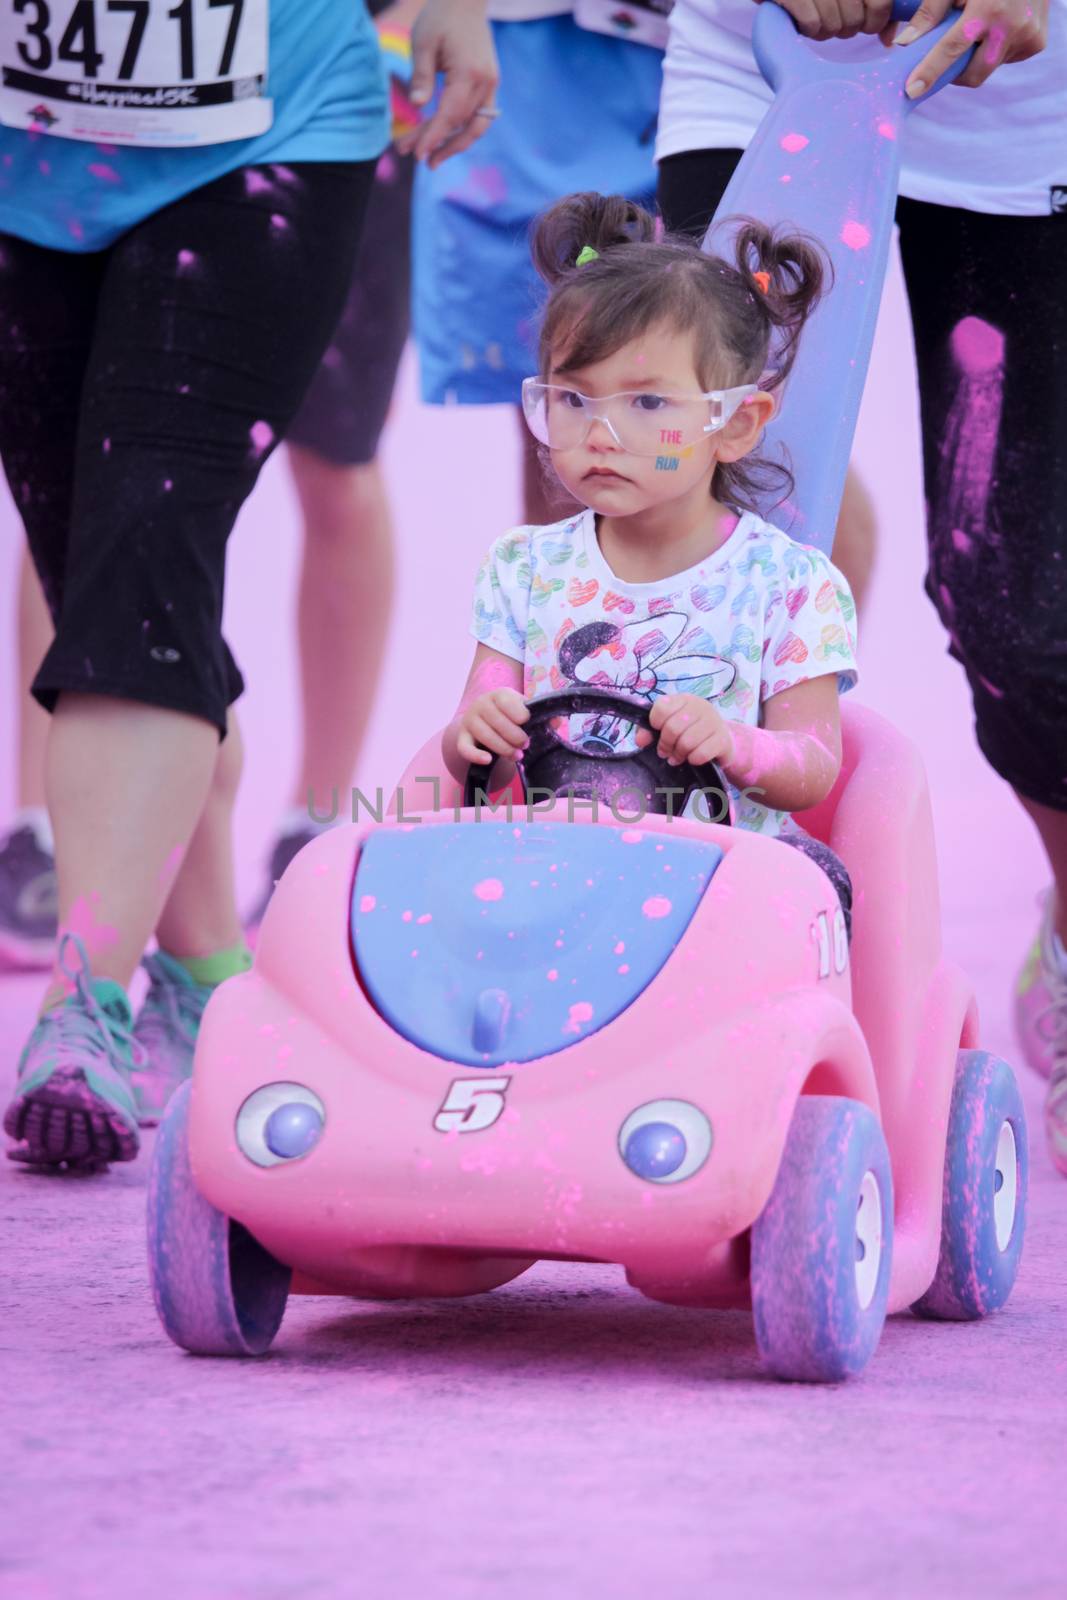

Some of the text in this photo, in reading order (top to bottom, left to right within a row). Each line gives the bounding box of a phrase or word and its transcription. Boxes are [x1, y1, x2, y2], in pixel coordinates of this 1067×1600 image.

[12, 0, 244, 80] 34717
[656, 429, 683, 446] THE
[655, 455, 681, 472] RUN
[432, 1075, 513, 1134] 5
